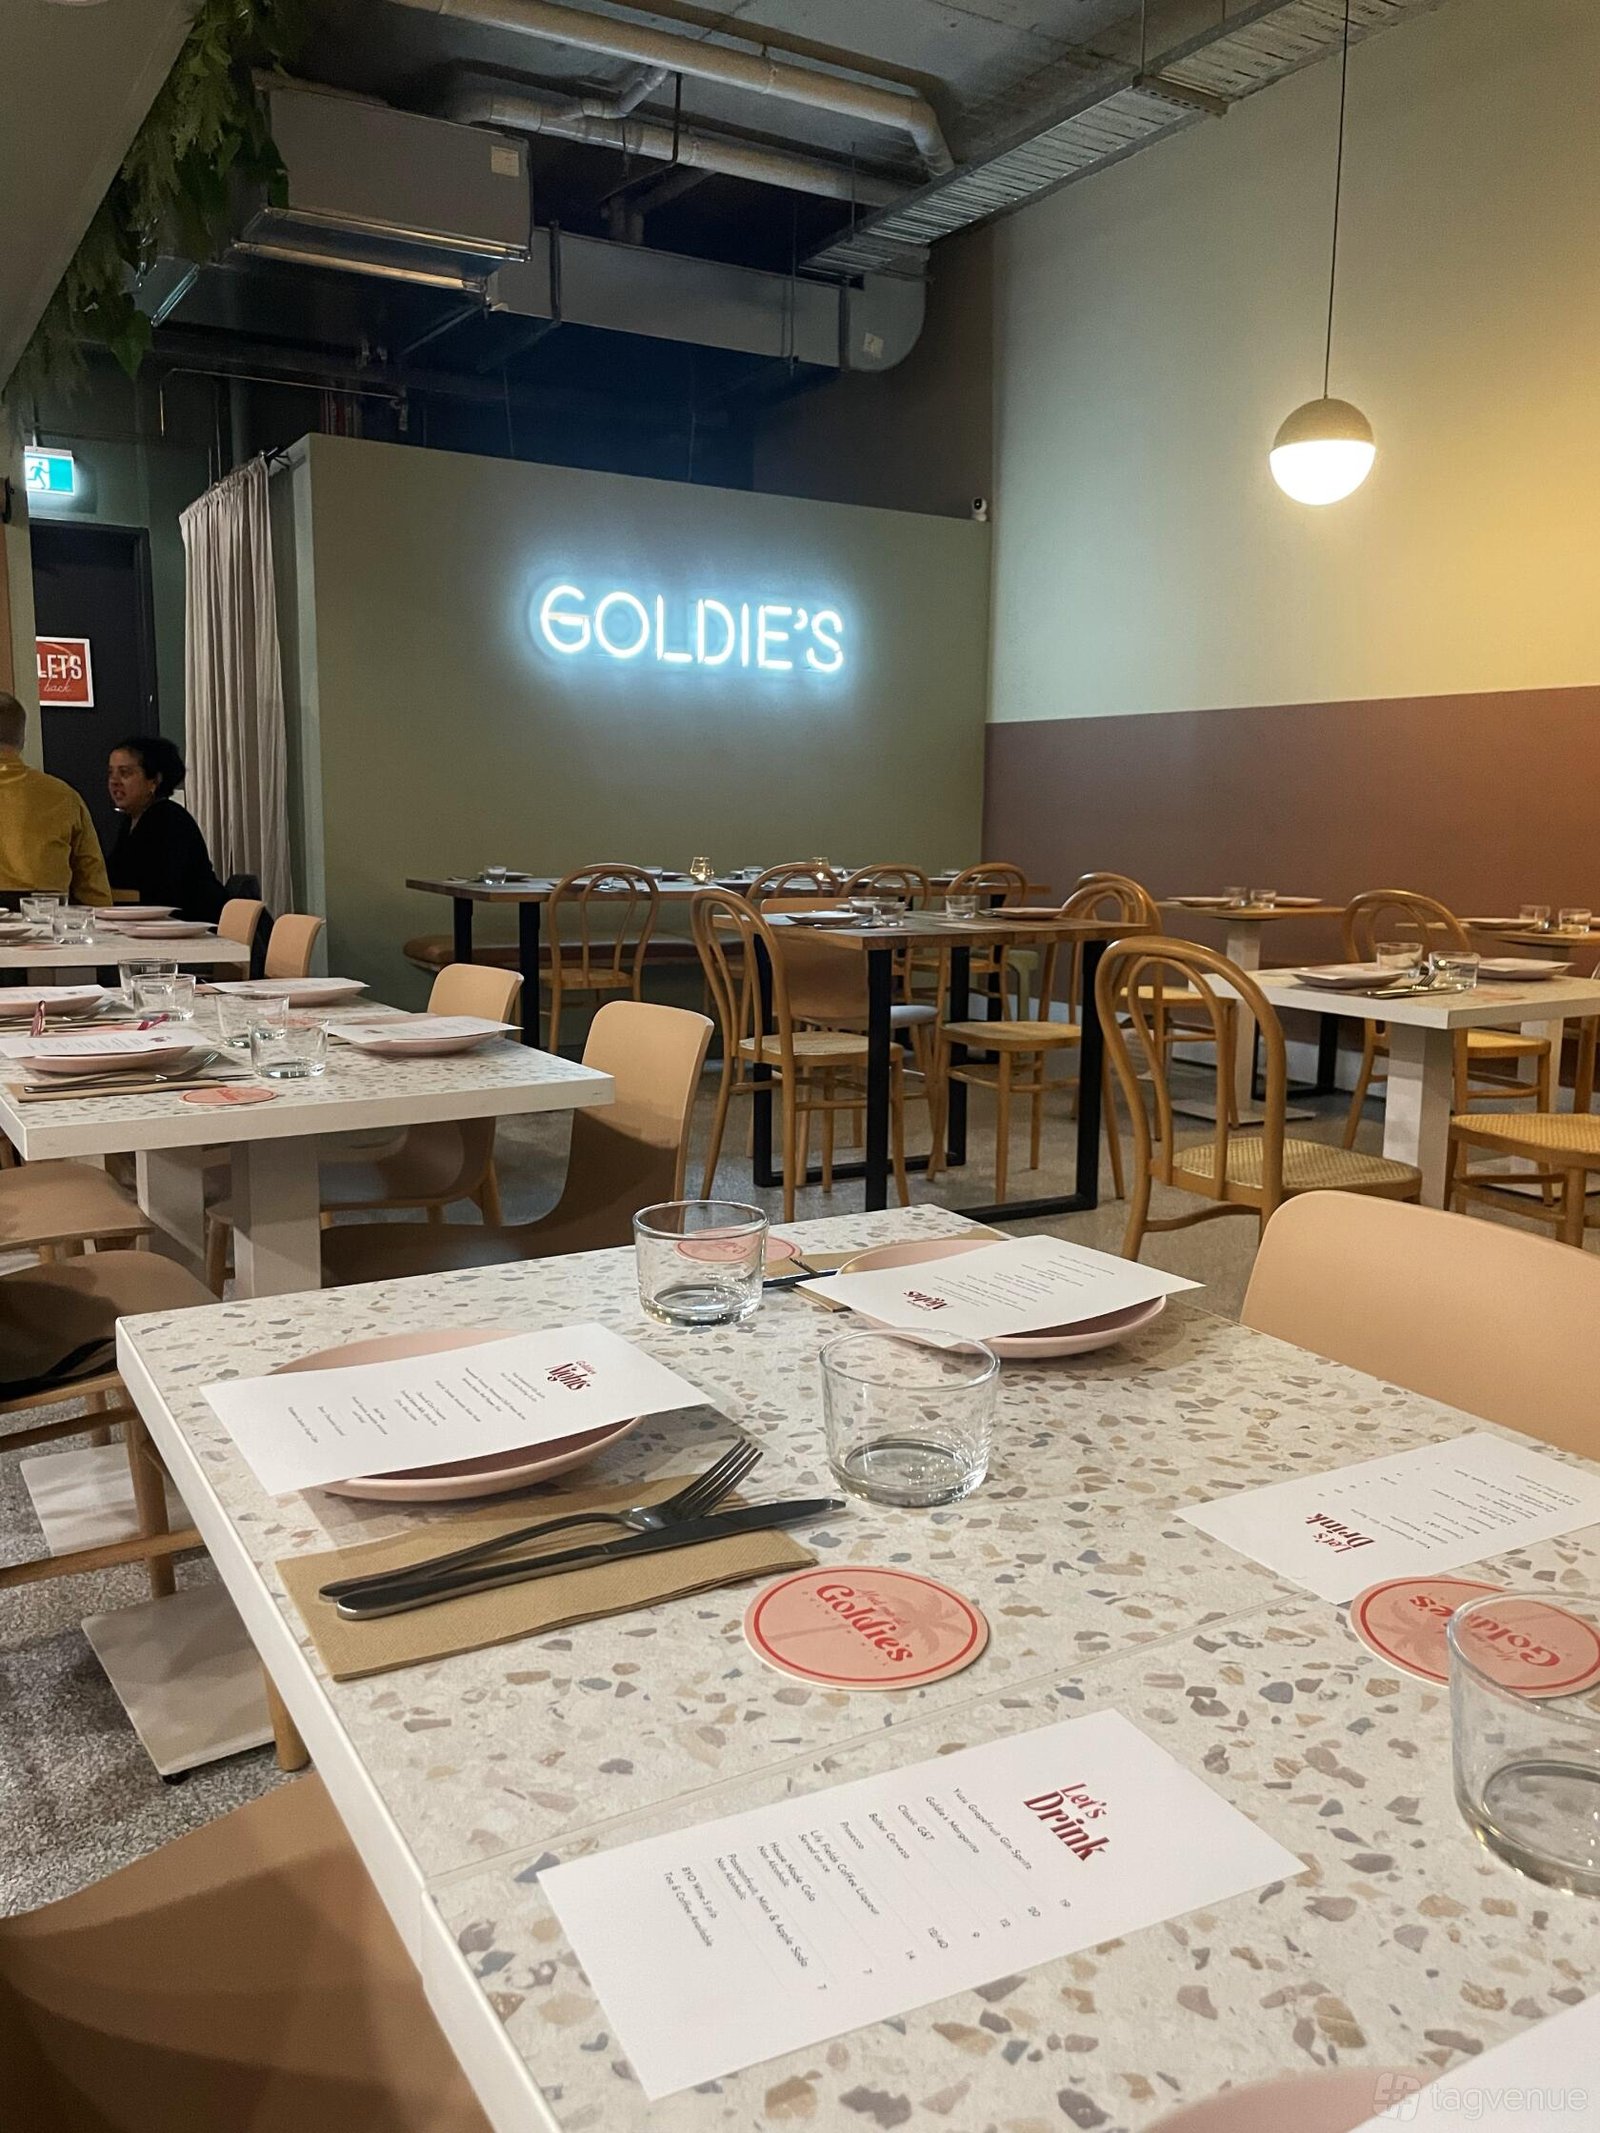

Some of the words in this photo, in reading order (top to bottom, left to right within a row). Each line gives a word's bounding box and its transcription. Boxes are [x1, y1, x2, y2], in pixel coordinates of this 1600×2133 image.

[540, 585, 845, 673] GOLDIE'S
[544, 1363, 592, 1391] Nights
[1305, 1512, 1375, 1549] Drink
[1312, 1532, 1353, 1554] Let's
[1061, 1783, 1107, 1819] Let's
[1023, 1790, 1110, 1862] Drink
